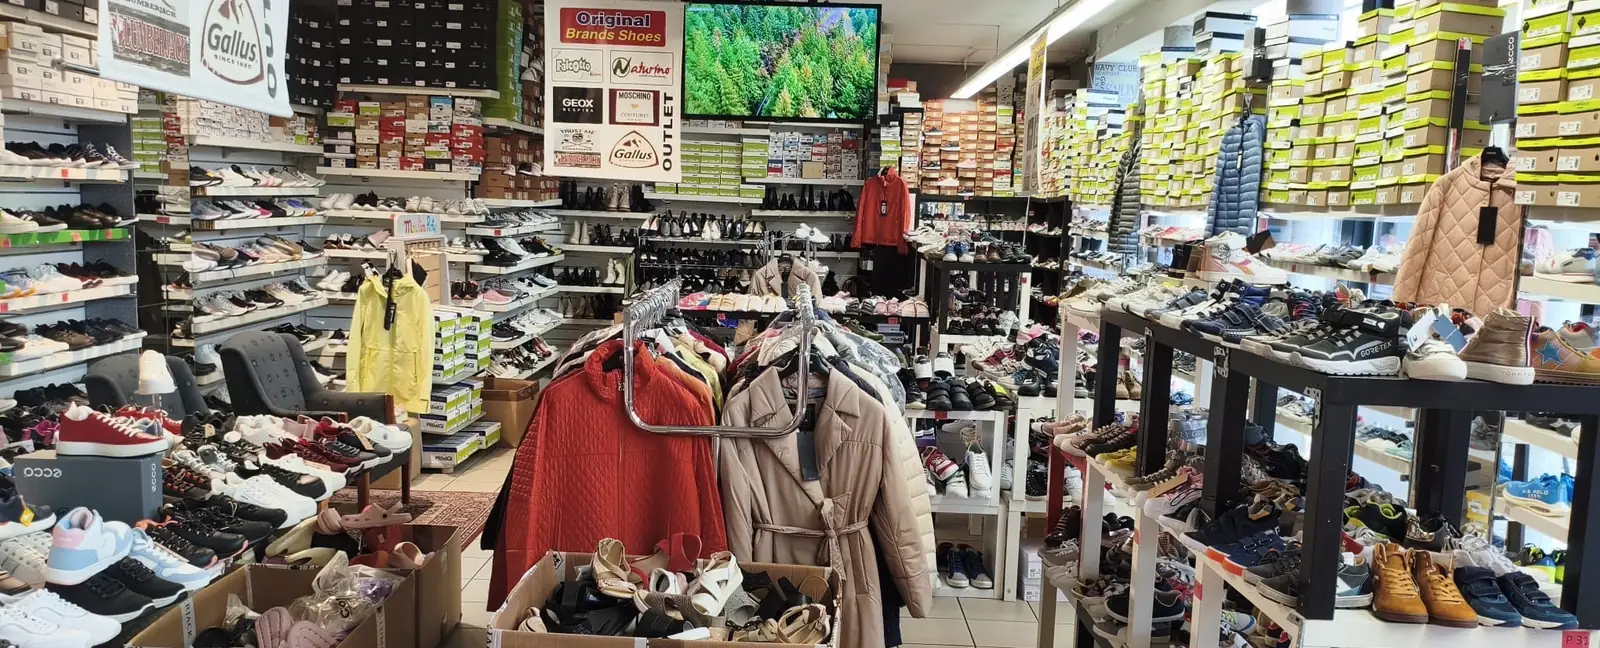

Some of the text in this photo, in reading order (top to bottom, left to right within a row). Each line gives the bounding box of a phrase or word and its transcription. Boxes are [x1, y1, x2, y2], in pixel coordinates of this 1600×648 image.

[576, 10, 651, 28] Original
[565, 27, 662, 42] Brands Shoes
[207, 23, 257, 63] Gallus
[612, 57, 672, 78] Naturino
[562, 98, 594, 108] GEOX
[618, 91, 651, 100] MOSCHINO
[662, 92, 673, 171] OUTLET
[614, 149, 652, 160] Gallus
[1360, 340, 1392, 358] GORE-TEX
[23, 467, 63, 478] ecco
[1566, 635, 1573, 645] P
